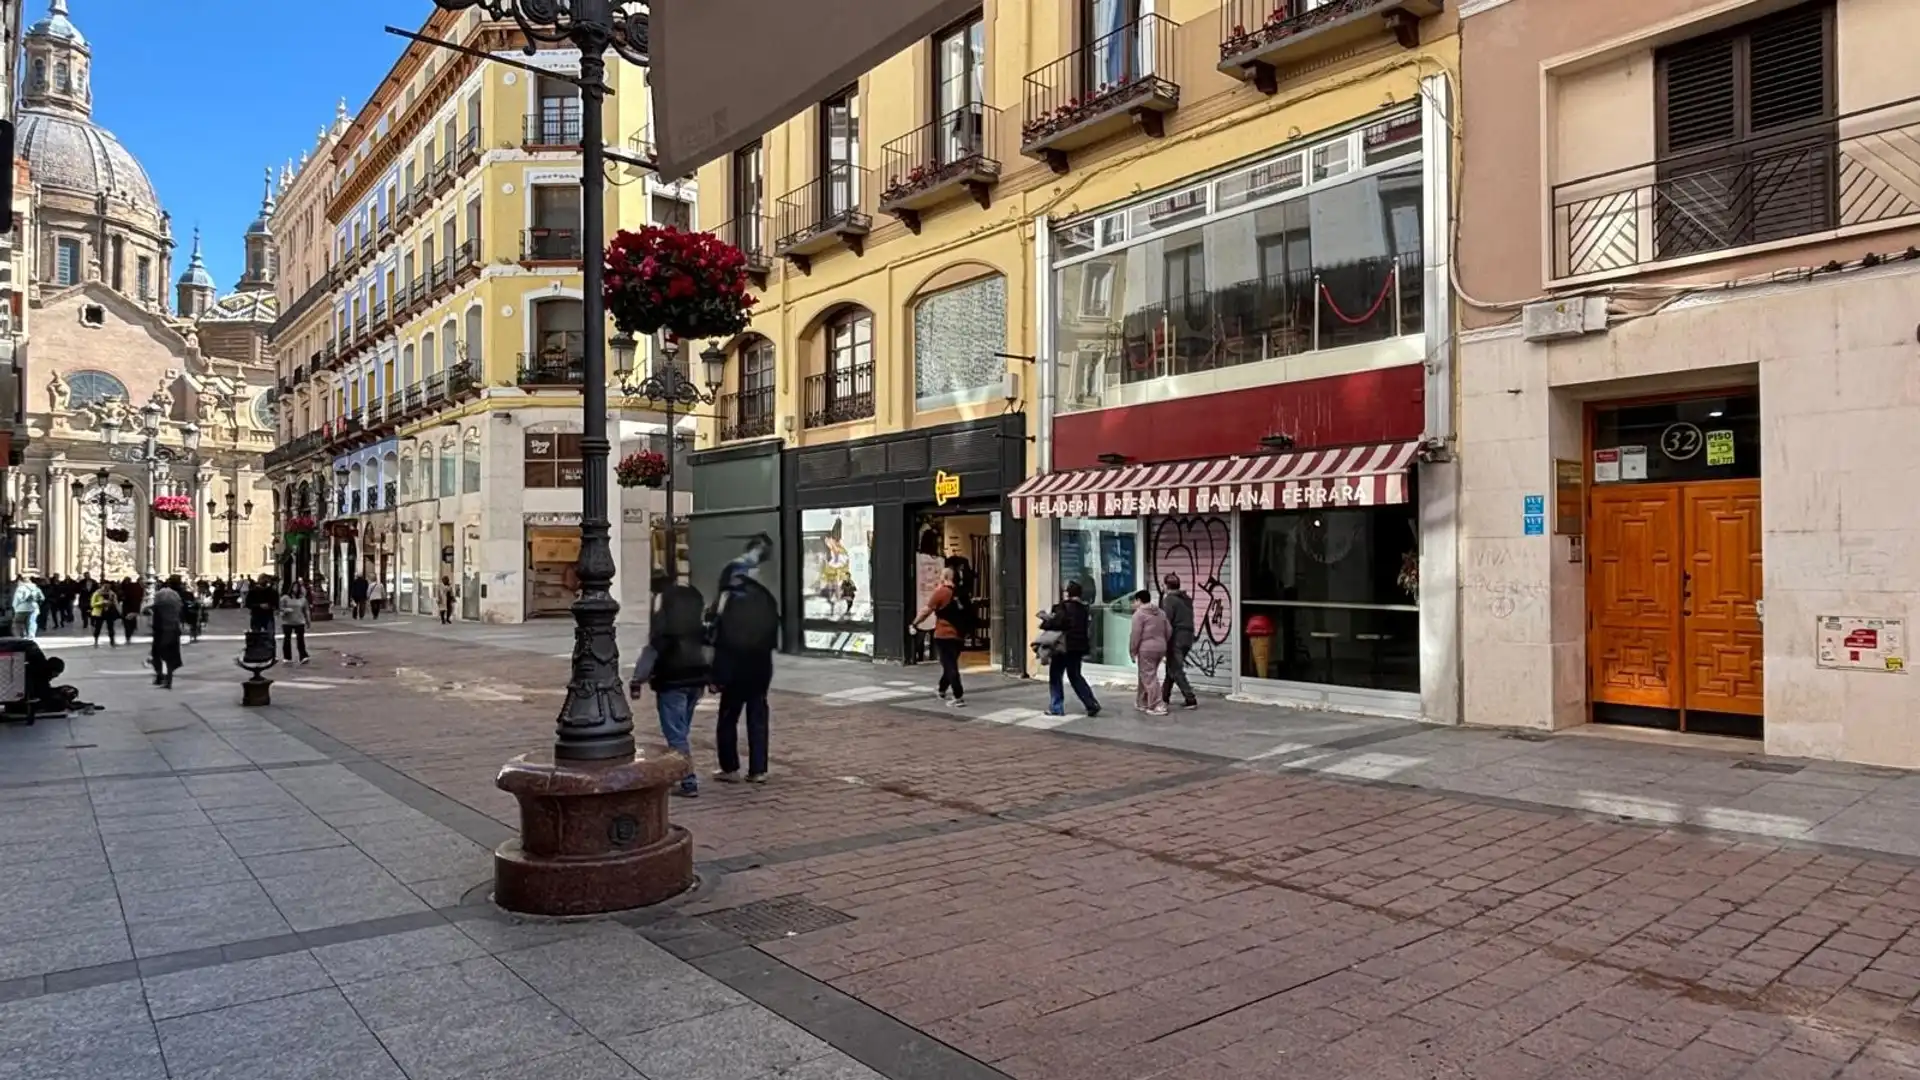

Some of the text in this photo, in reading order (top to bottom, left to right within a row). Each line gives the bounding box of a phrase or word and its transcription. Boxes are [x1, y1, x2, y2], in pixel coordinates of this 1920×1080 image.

[1667, 430, 1697, 451] 32
[1708, 432, 1732, 441] PISO
[1031, 484, 1367, 514] HELADERIA ARTESANAL ITALIANA FERRARA
